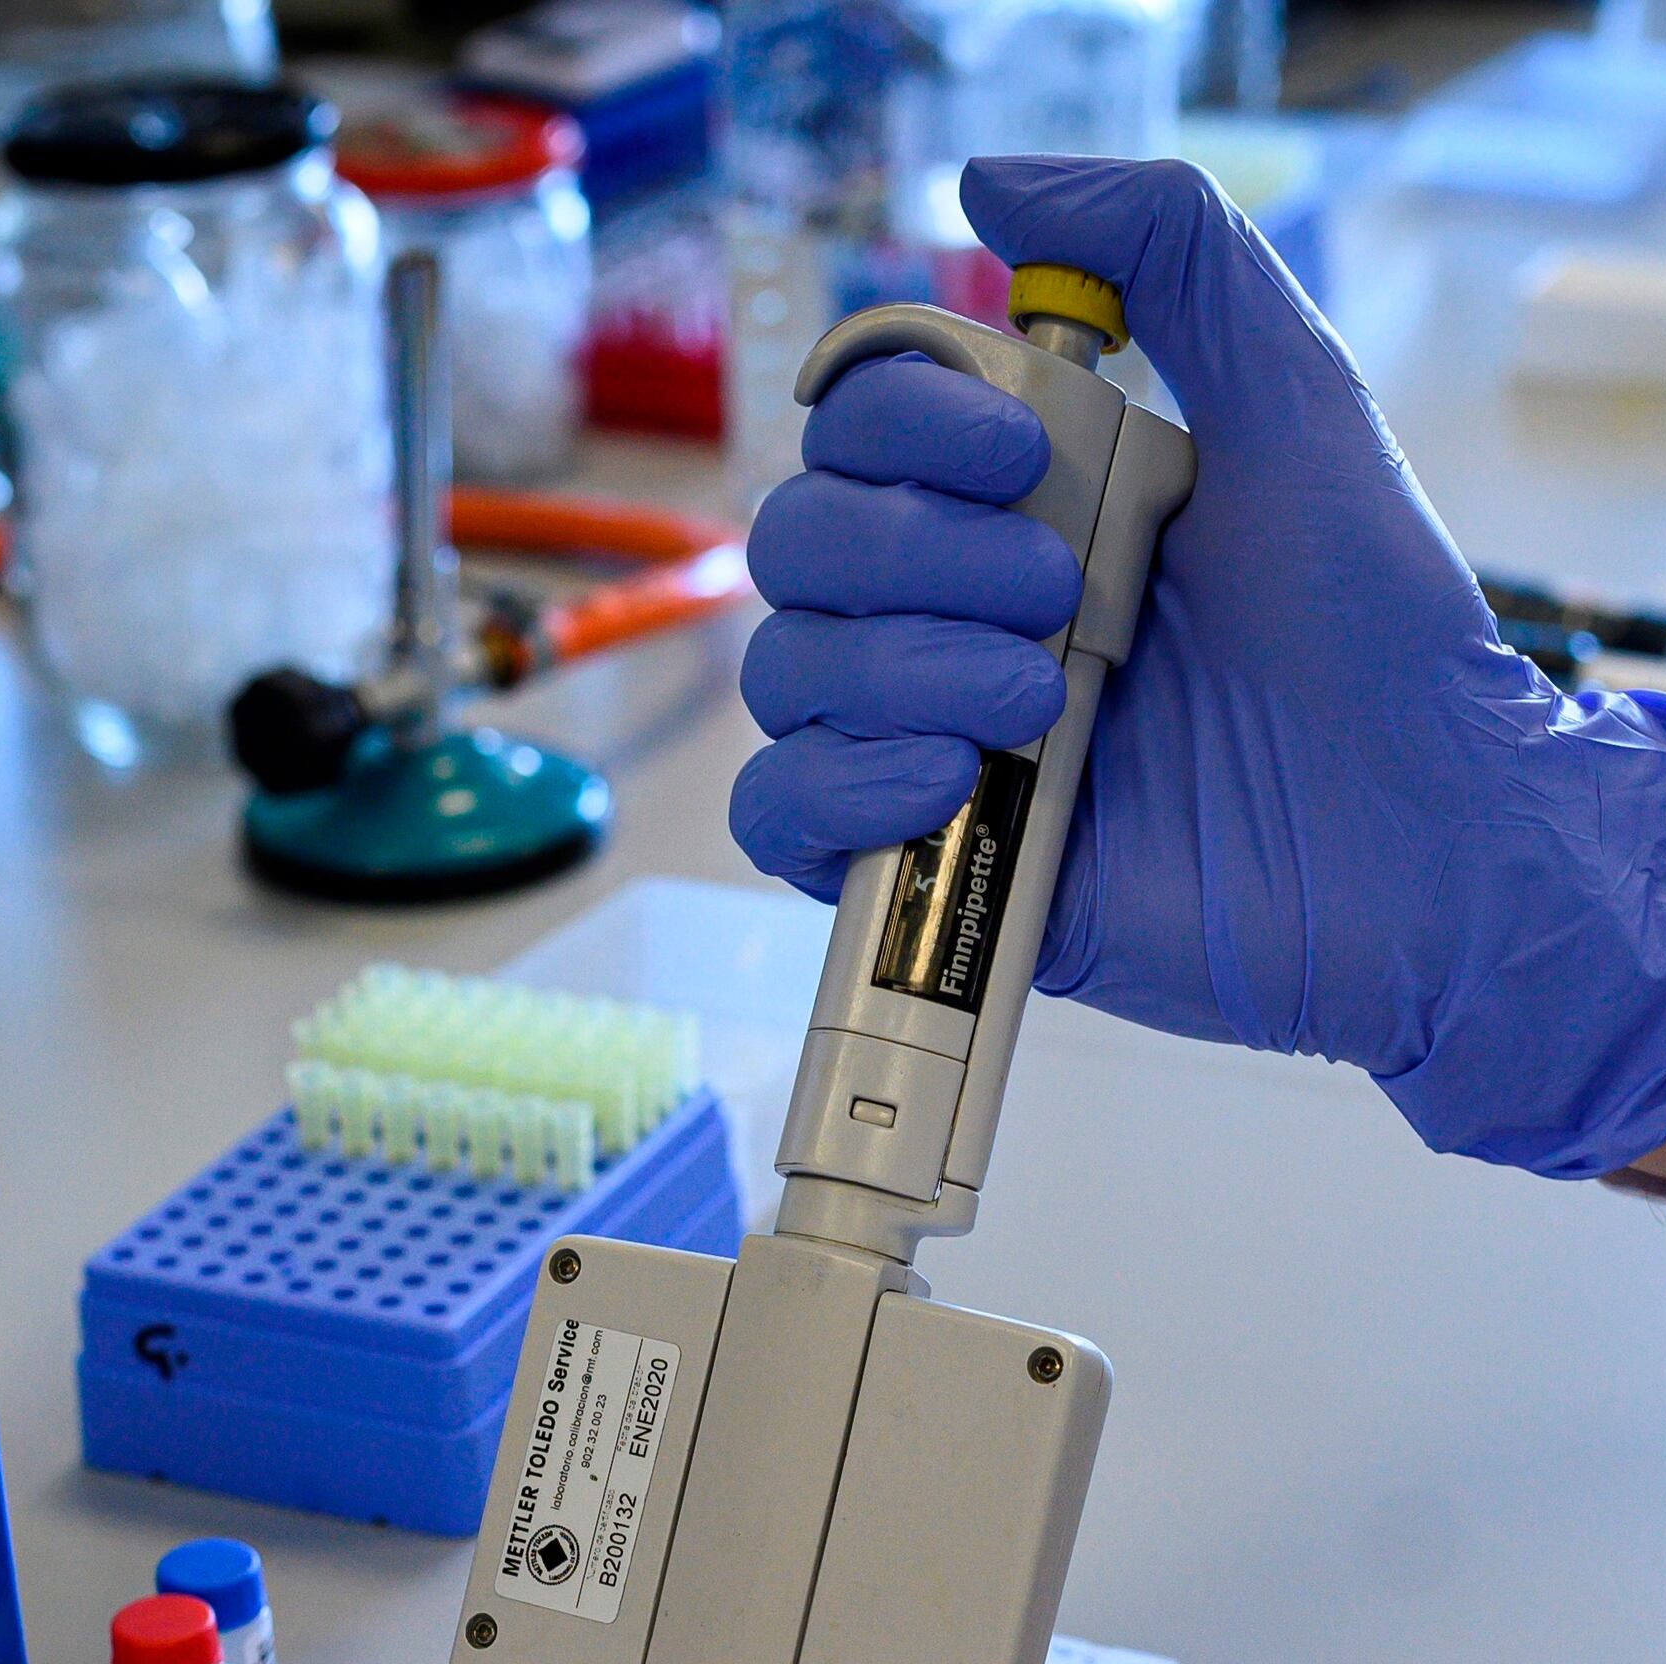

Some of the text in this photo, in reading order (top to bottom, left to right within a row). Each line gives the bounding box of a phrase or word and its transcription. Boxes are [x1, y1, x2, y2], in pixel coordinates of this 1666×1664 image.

[502, 1318, 580, 1578] METTLER TOLEDO Service
[551, 1329, 604, 1511] laboratorio.calibracion@mt.com
[581, 1393, 607, 1469] 902.32.00.23
[628, 1358, 669, 1459] ENE2020
[598, 1493, 637, 1587] B200132
